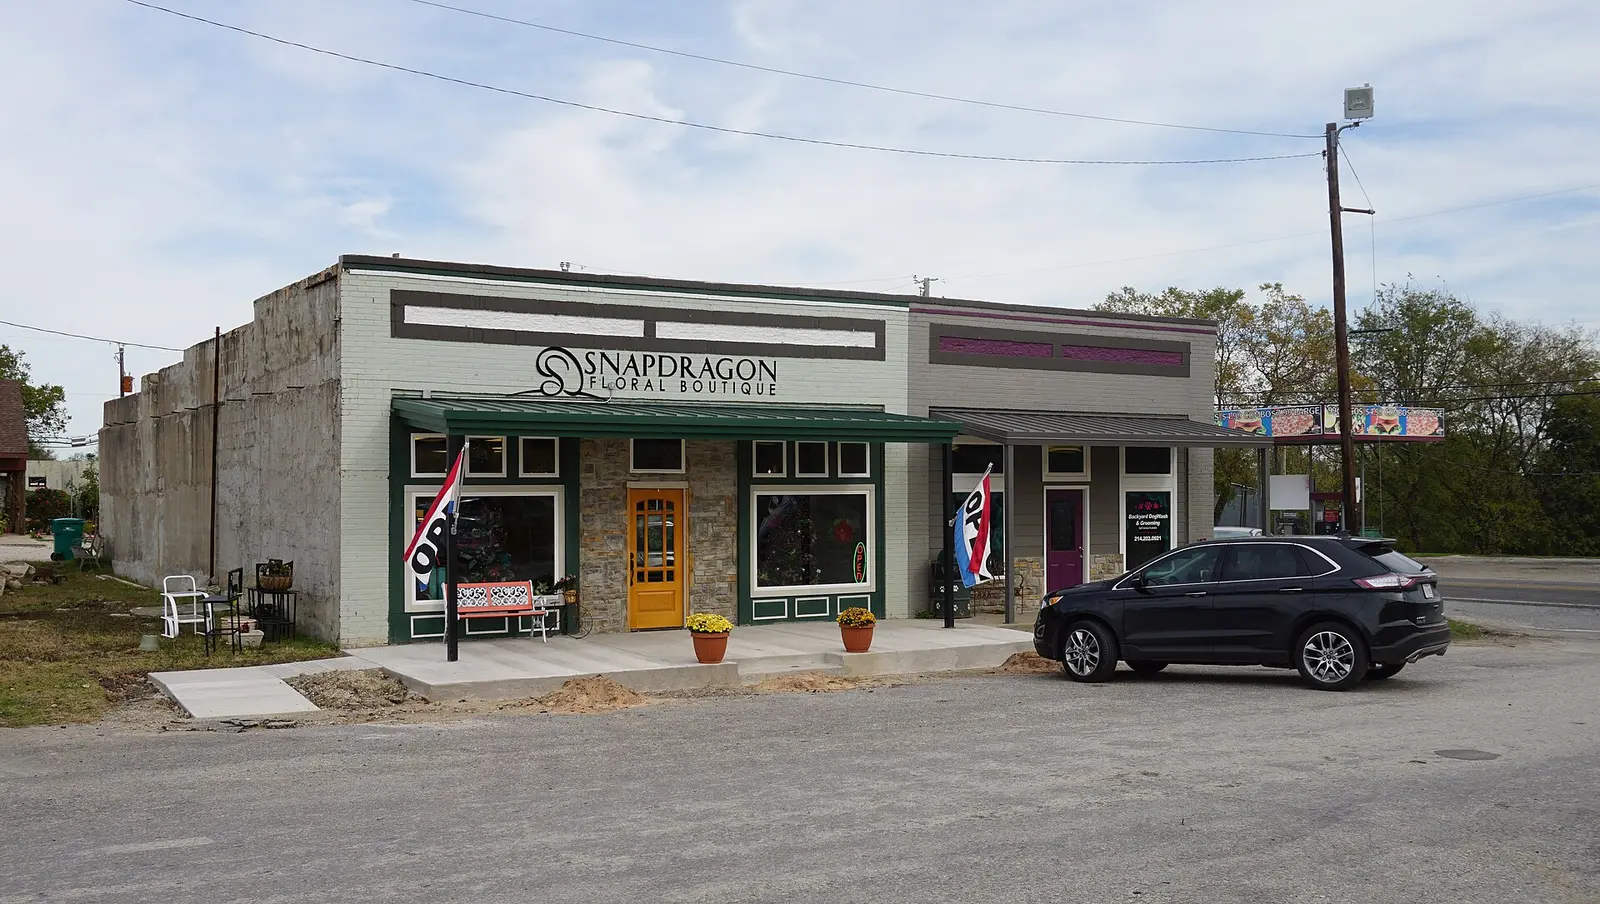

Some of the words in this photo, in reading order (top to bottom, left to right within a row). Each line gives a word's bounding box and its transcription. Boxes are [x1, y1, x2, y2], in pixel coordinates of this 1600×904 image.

[584, 351, 777, 382] SNAPDRAGON
[589, 376, 665, 392] FLORAL
[680, 379, 776, 396] BOUTIQUE
[856, 545, 864, 580] OPEN
